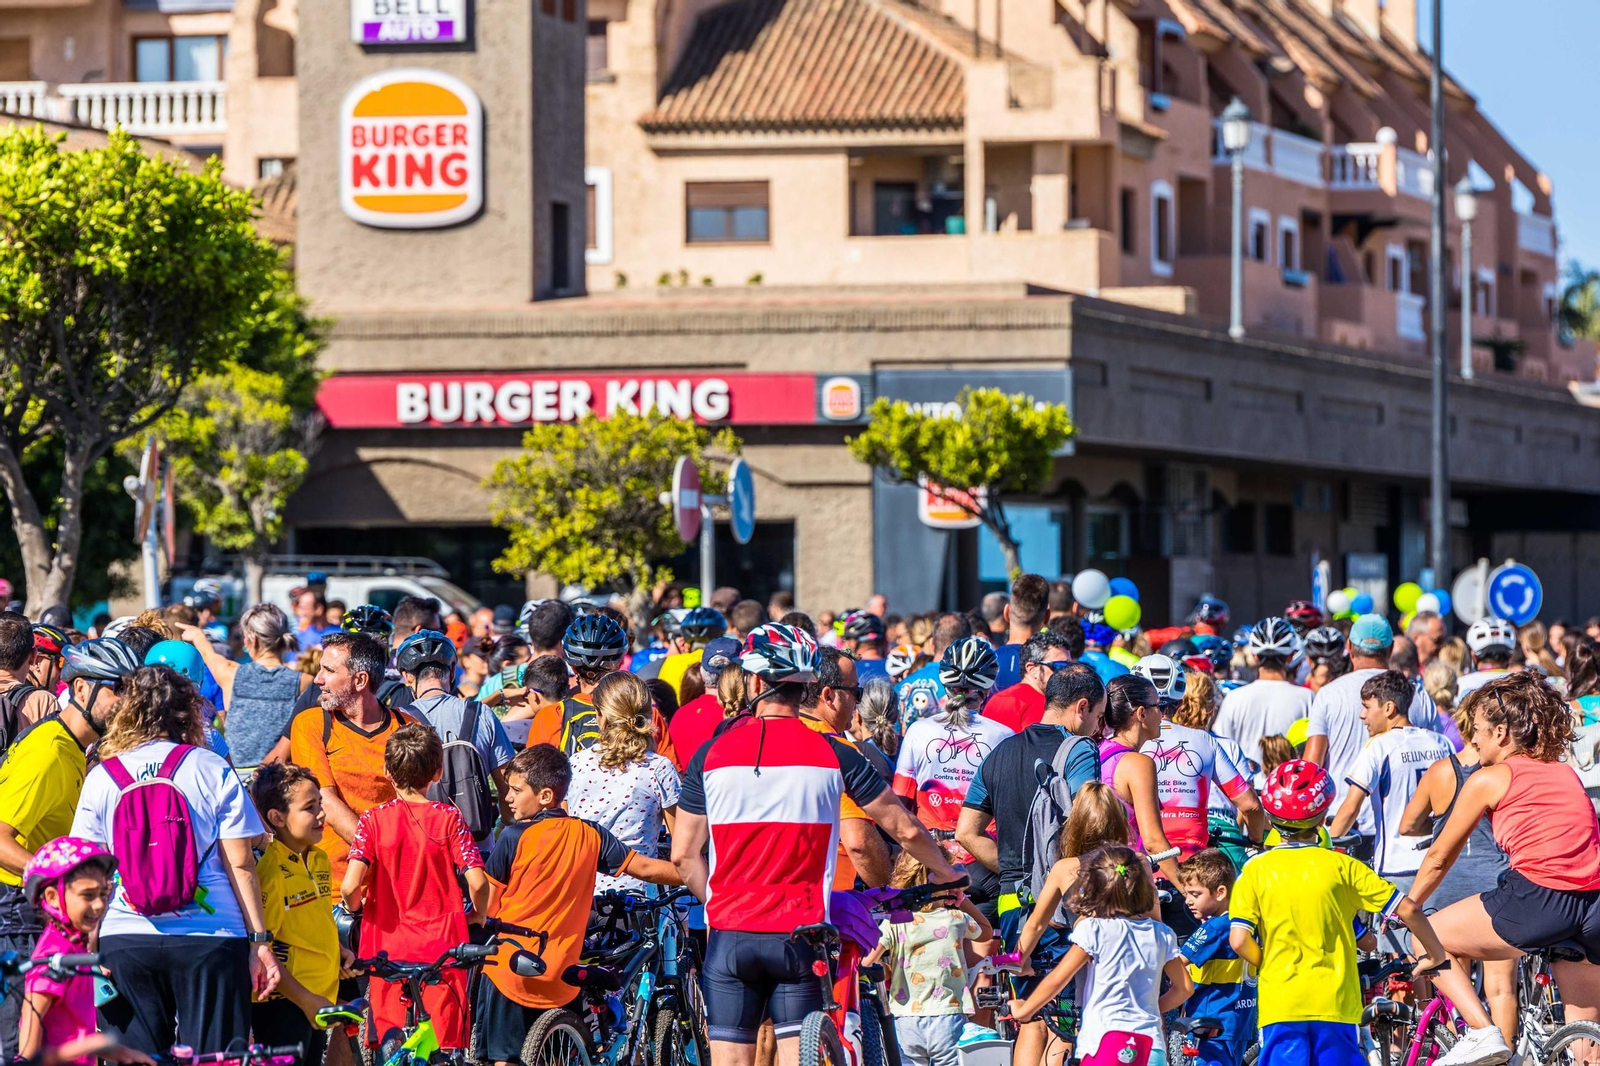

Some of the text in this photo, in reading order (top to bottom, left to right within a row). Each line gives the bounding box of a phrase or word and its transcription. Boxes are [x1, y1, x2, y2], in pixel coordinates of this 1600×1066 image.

[374, 0, 451, 15] BELL
[378, 20, 440, 41] AUTO
[352, 124, 468, 148] BURGER
[352, 152, 468, 188] KING
[396, 378, 730, 423] BURGER KING
